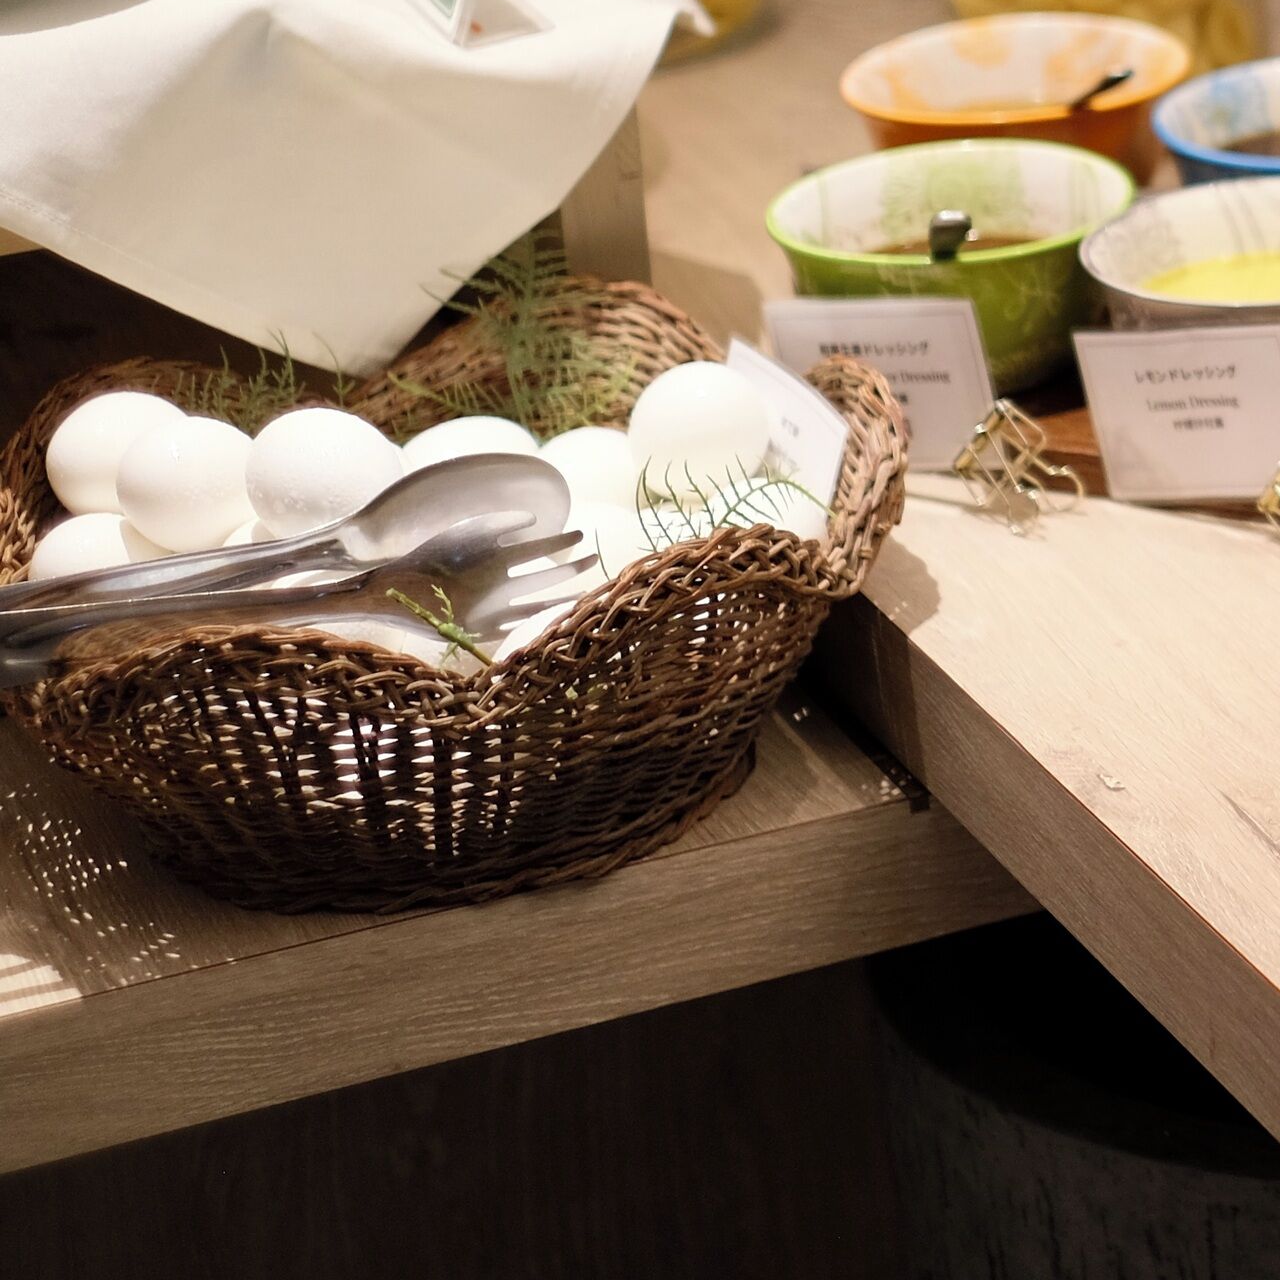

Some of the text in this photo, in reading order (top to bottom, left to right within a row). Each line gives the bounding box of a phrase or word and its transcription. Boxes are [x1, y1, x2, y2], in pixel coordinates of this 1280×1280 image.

[1134, 364, 1236, 384] レモンドレッシング
[1146, 394, 1240, 412] Lemon Dressing
